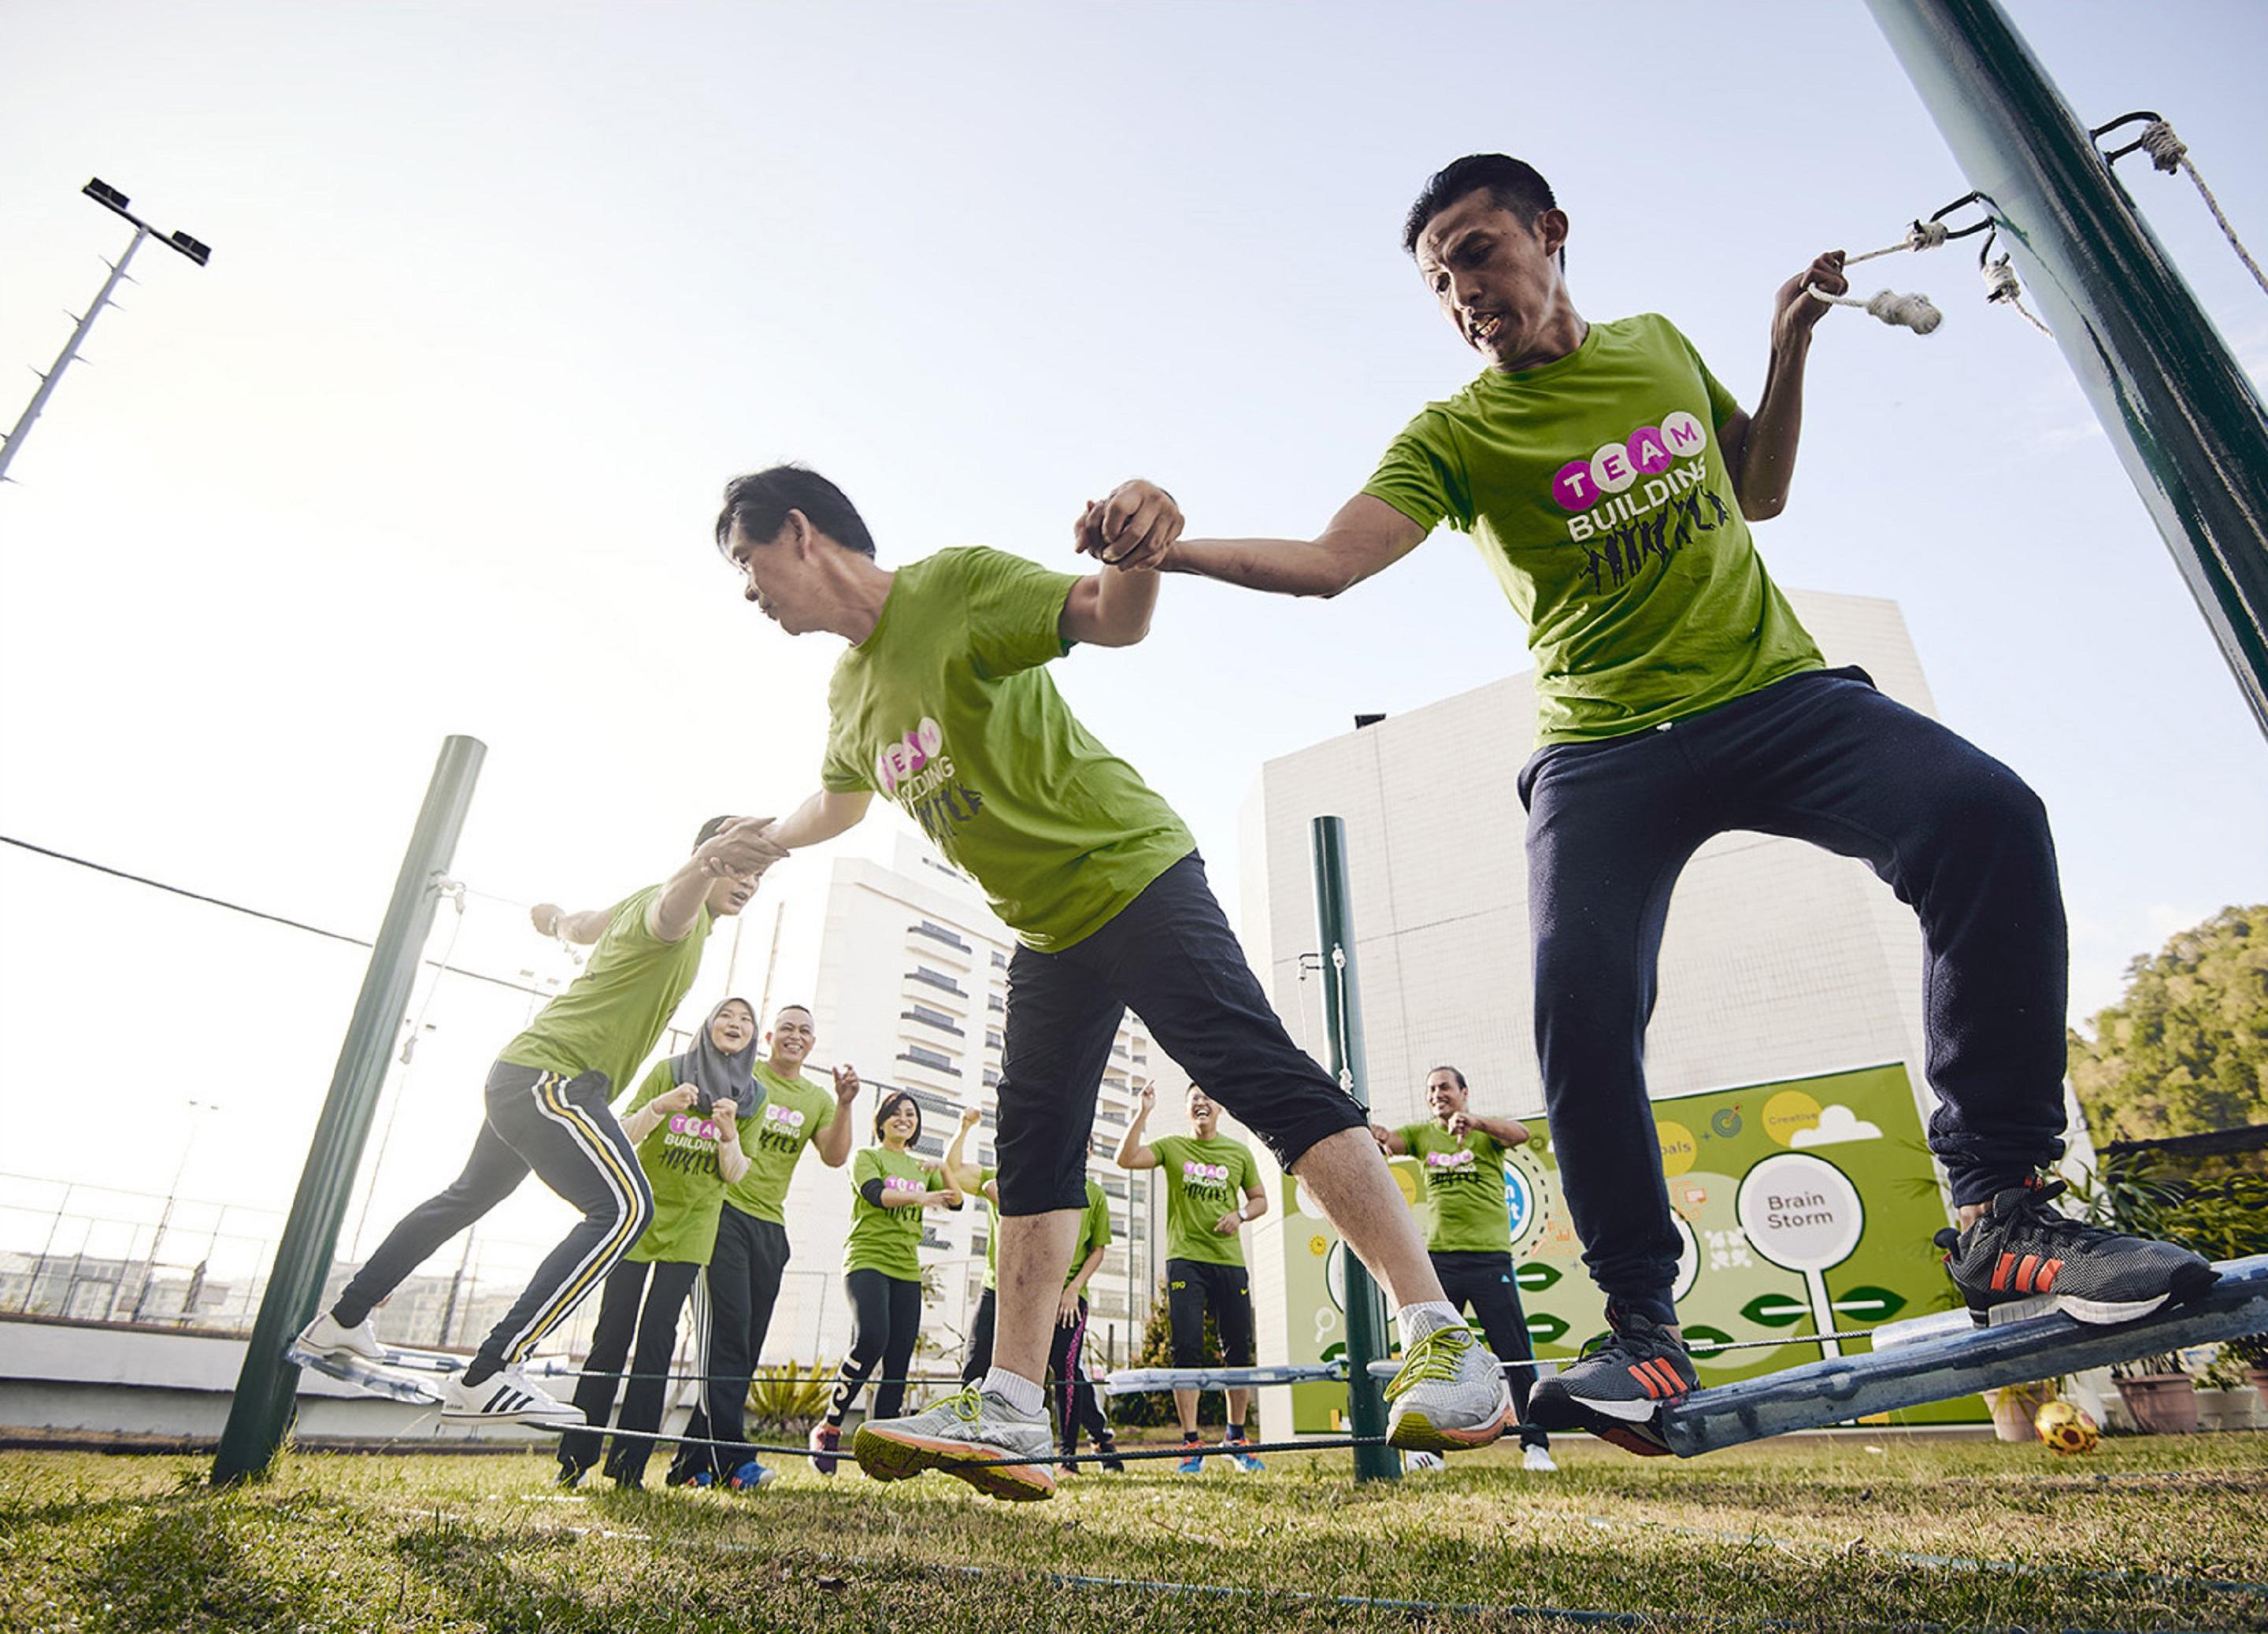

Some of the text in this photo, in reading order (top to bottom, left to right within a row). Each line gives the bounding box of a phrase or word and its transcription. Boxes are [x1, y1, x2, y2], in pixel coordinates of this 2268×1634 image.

[1558, 416, 1702, 504] TEAM
[884, 721, 940, 780] EAM
[767, 1106, 803, 1125] EAM
[1769, 1113, 1818, 1125] Creative
[673, 1115, 717, 1139] TEA
[664, 1132, 717, 1154] BUILDIN
[1661, 1141, 1692, 1155] oals
[1184, 1161, 1228, 1180] TEAM
[1768, 1191, 1825, 1210] Brain
[1768, 1212, 1833, 1228] Storm
